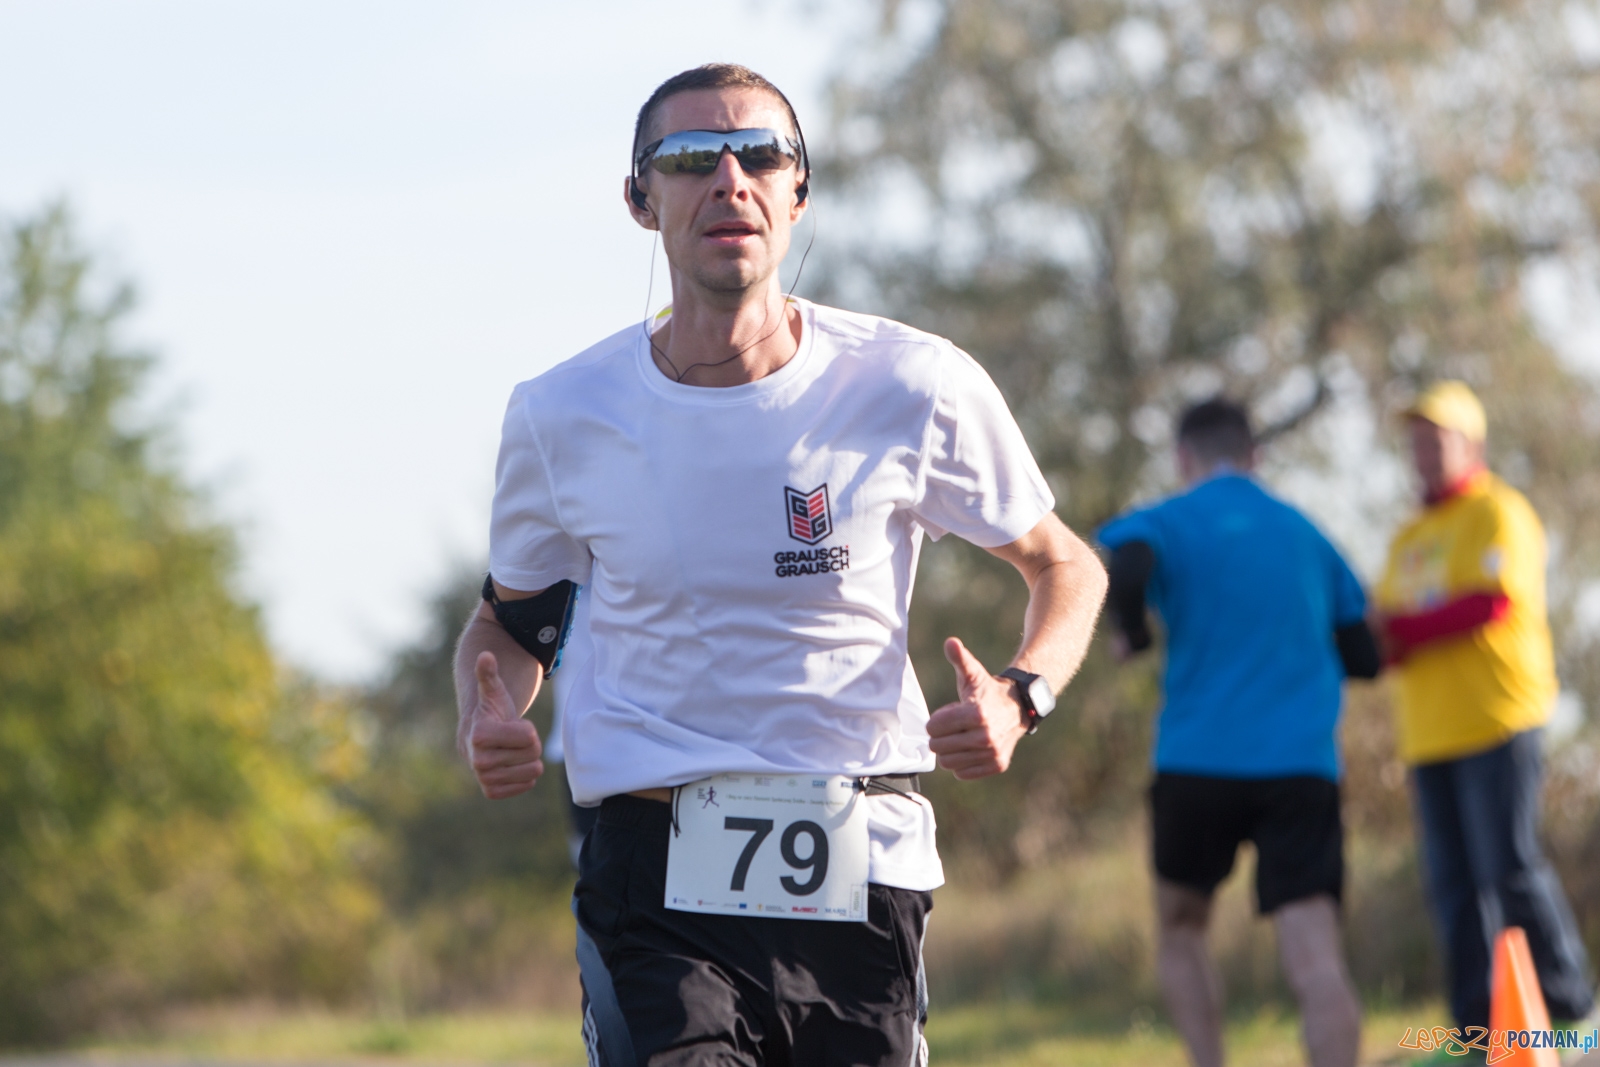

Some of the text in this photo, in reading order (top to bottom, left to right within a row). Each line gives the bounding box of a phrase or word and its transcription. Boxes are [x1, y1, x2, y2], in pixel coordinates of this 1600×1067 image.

[774, 547, 848, 564] GRAUSCH
[775, 559, 849, 577] GRAUSCH
[724, 816, 829, 896] 79
